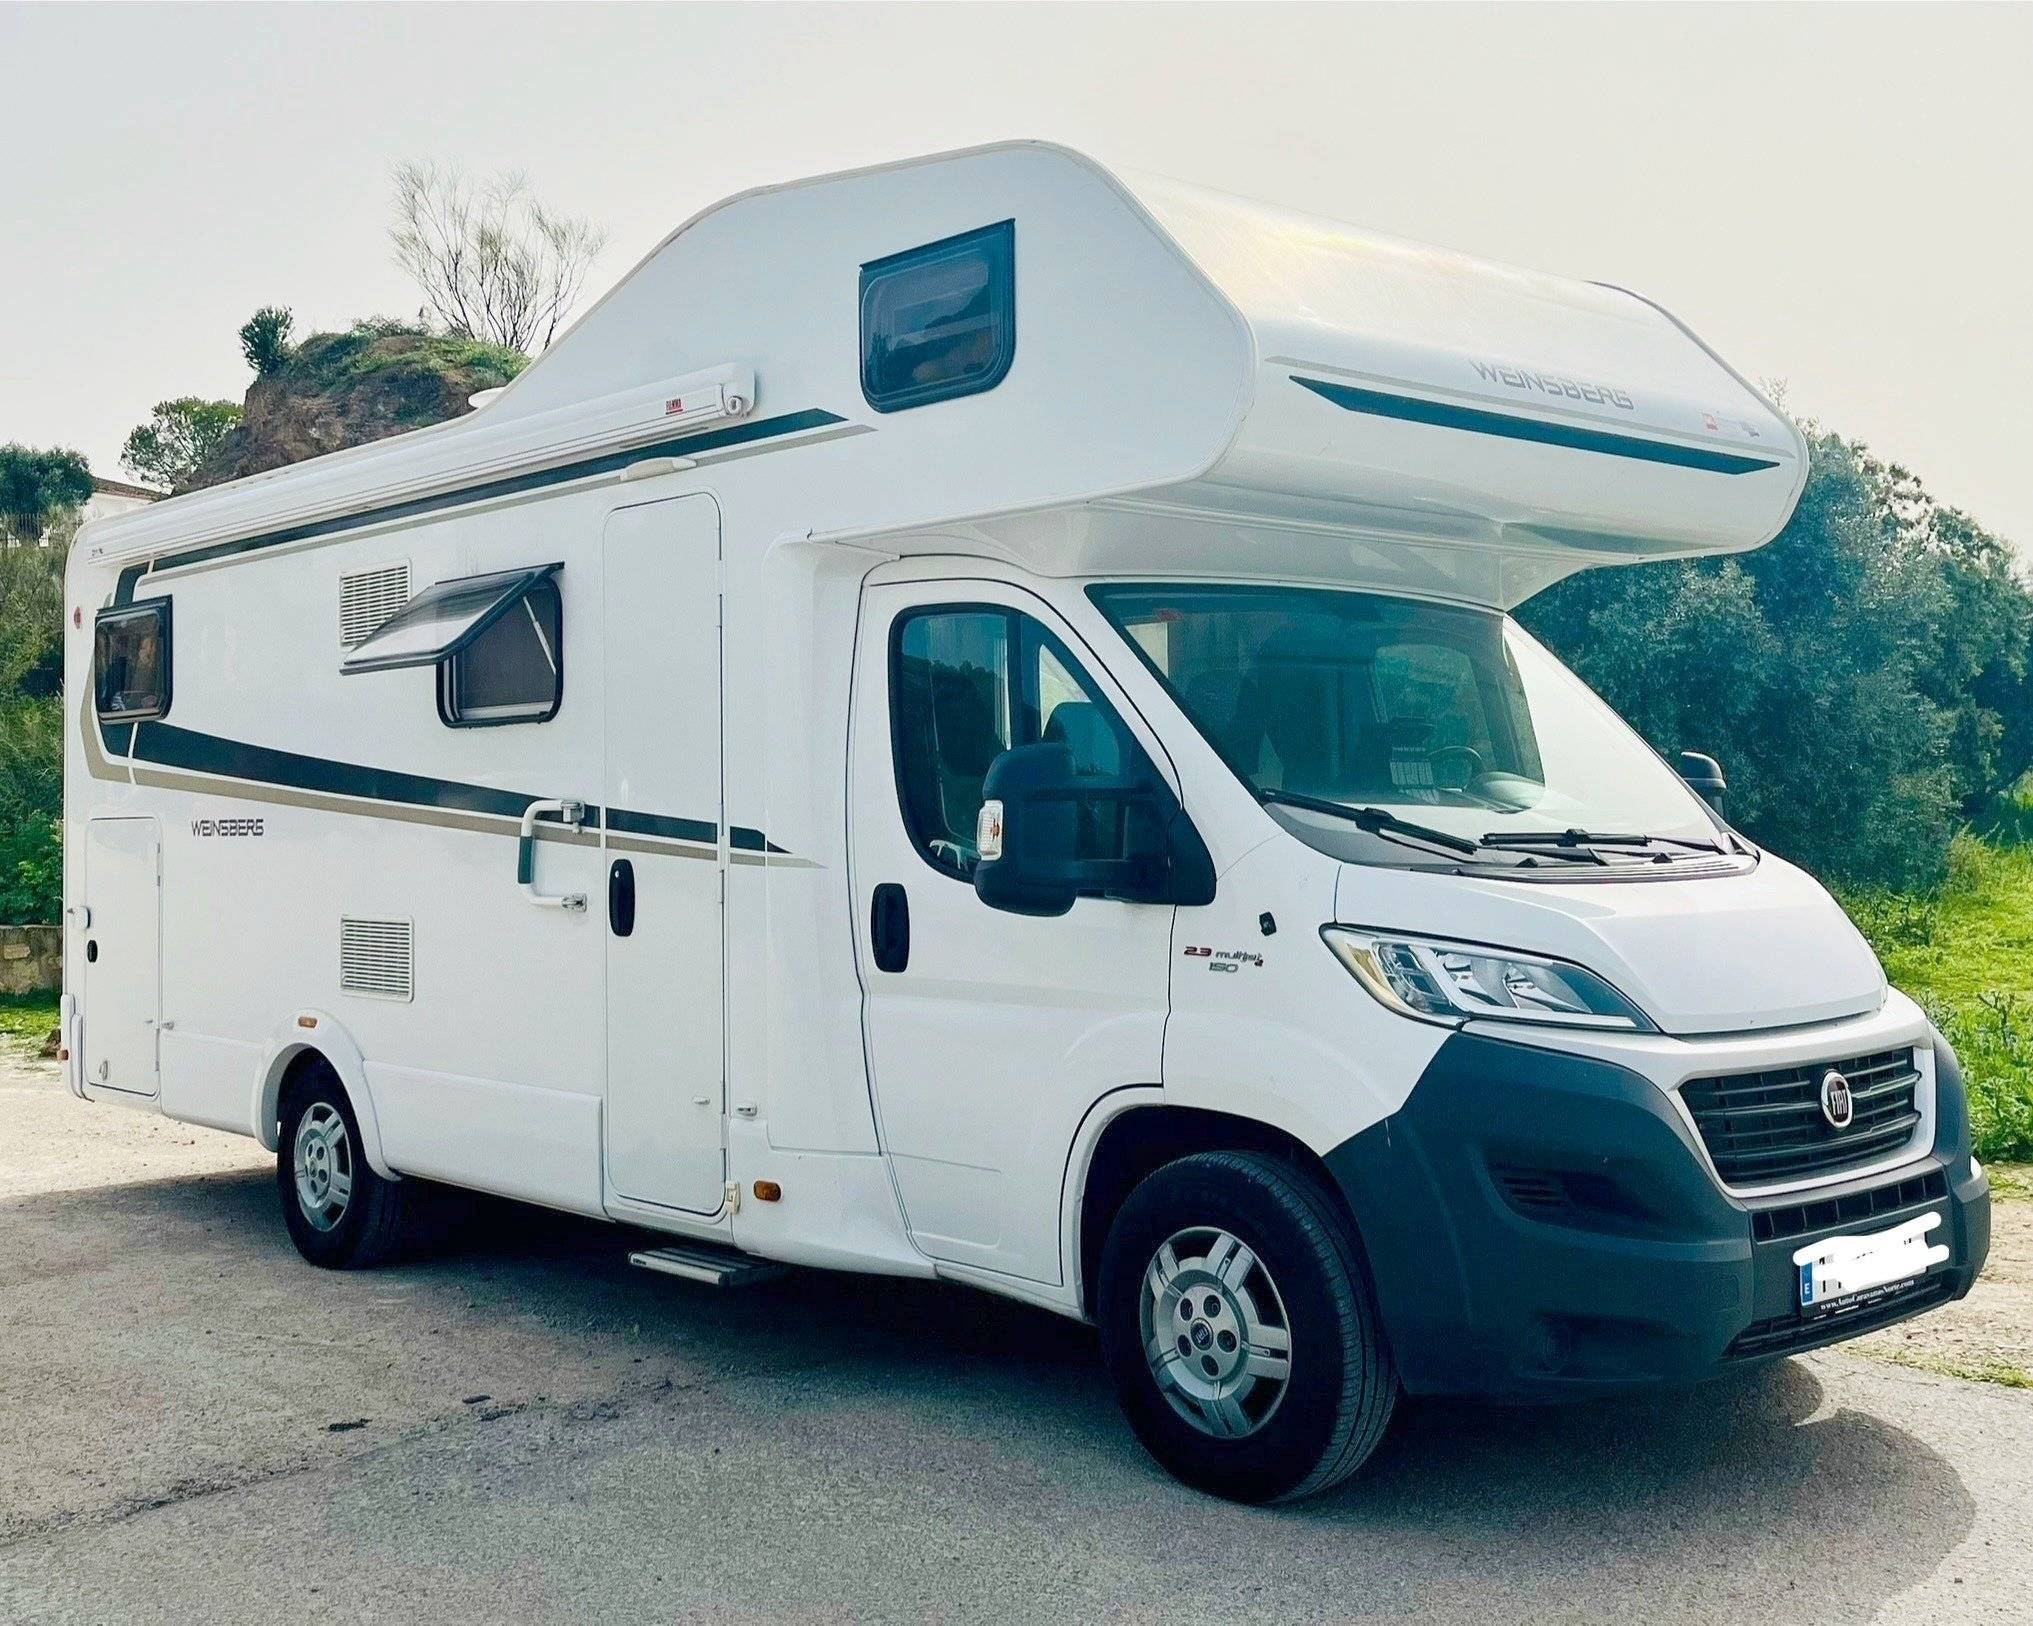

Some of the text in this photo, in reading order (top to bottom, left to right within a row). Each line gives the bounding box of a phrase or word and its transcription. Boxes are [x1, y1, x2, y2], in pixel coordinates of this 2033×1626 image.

[1469, 358, 1635, 410] WEINSBERG
[191, 818, 264, 837] WEINSBERG
[1209, 961, 1239, 973] 150
[1804, 1282, 1811, 1295] E
